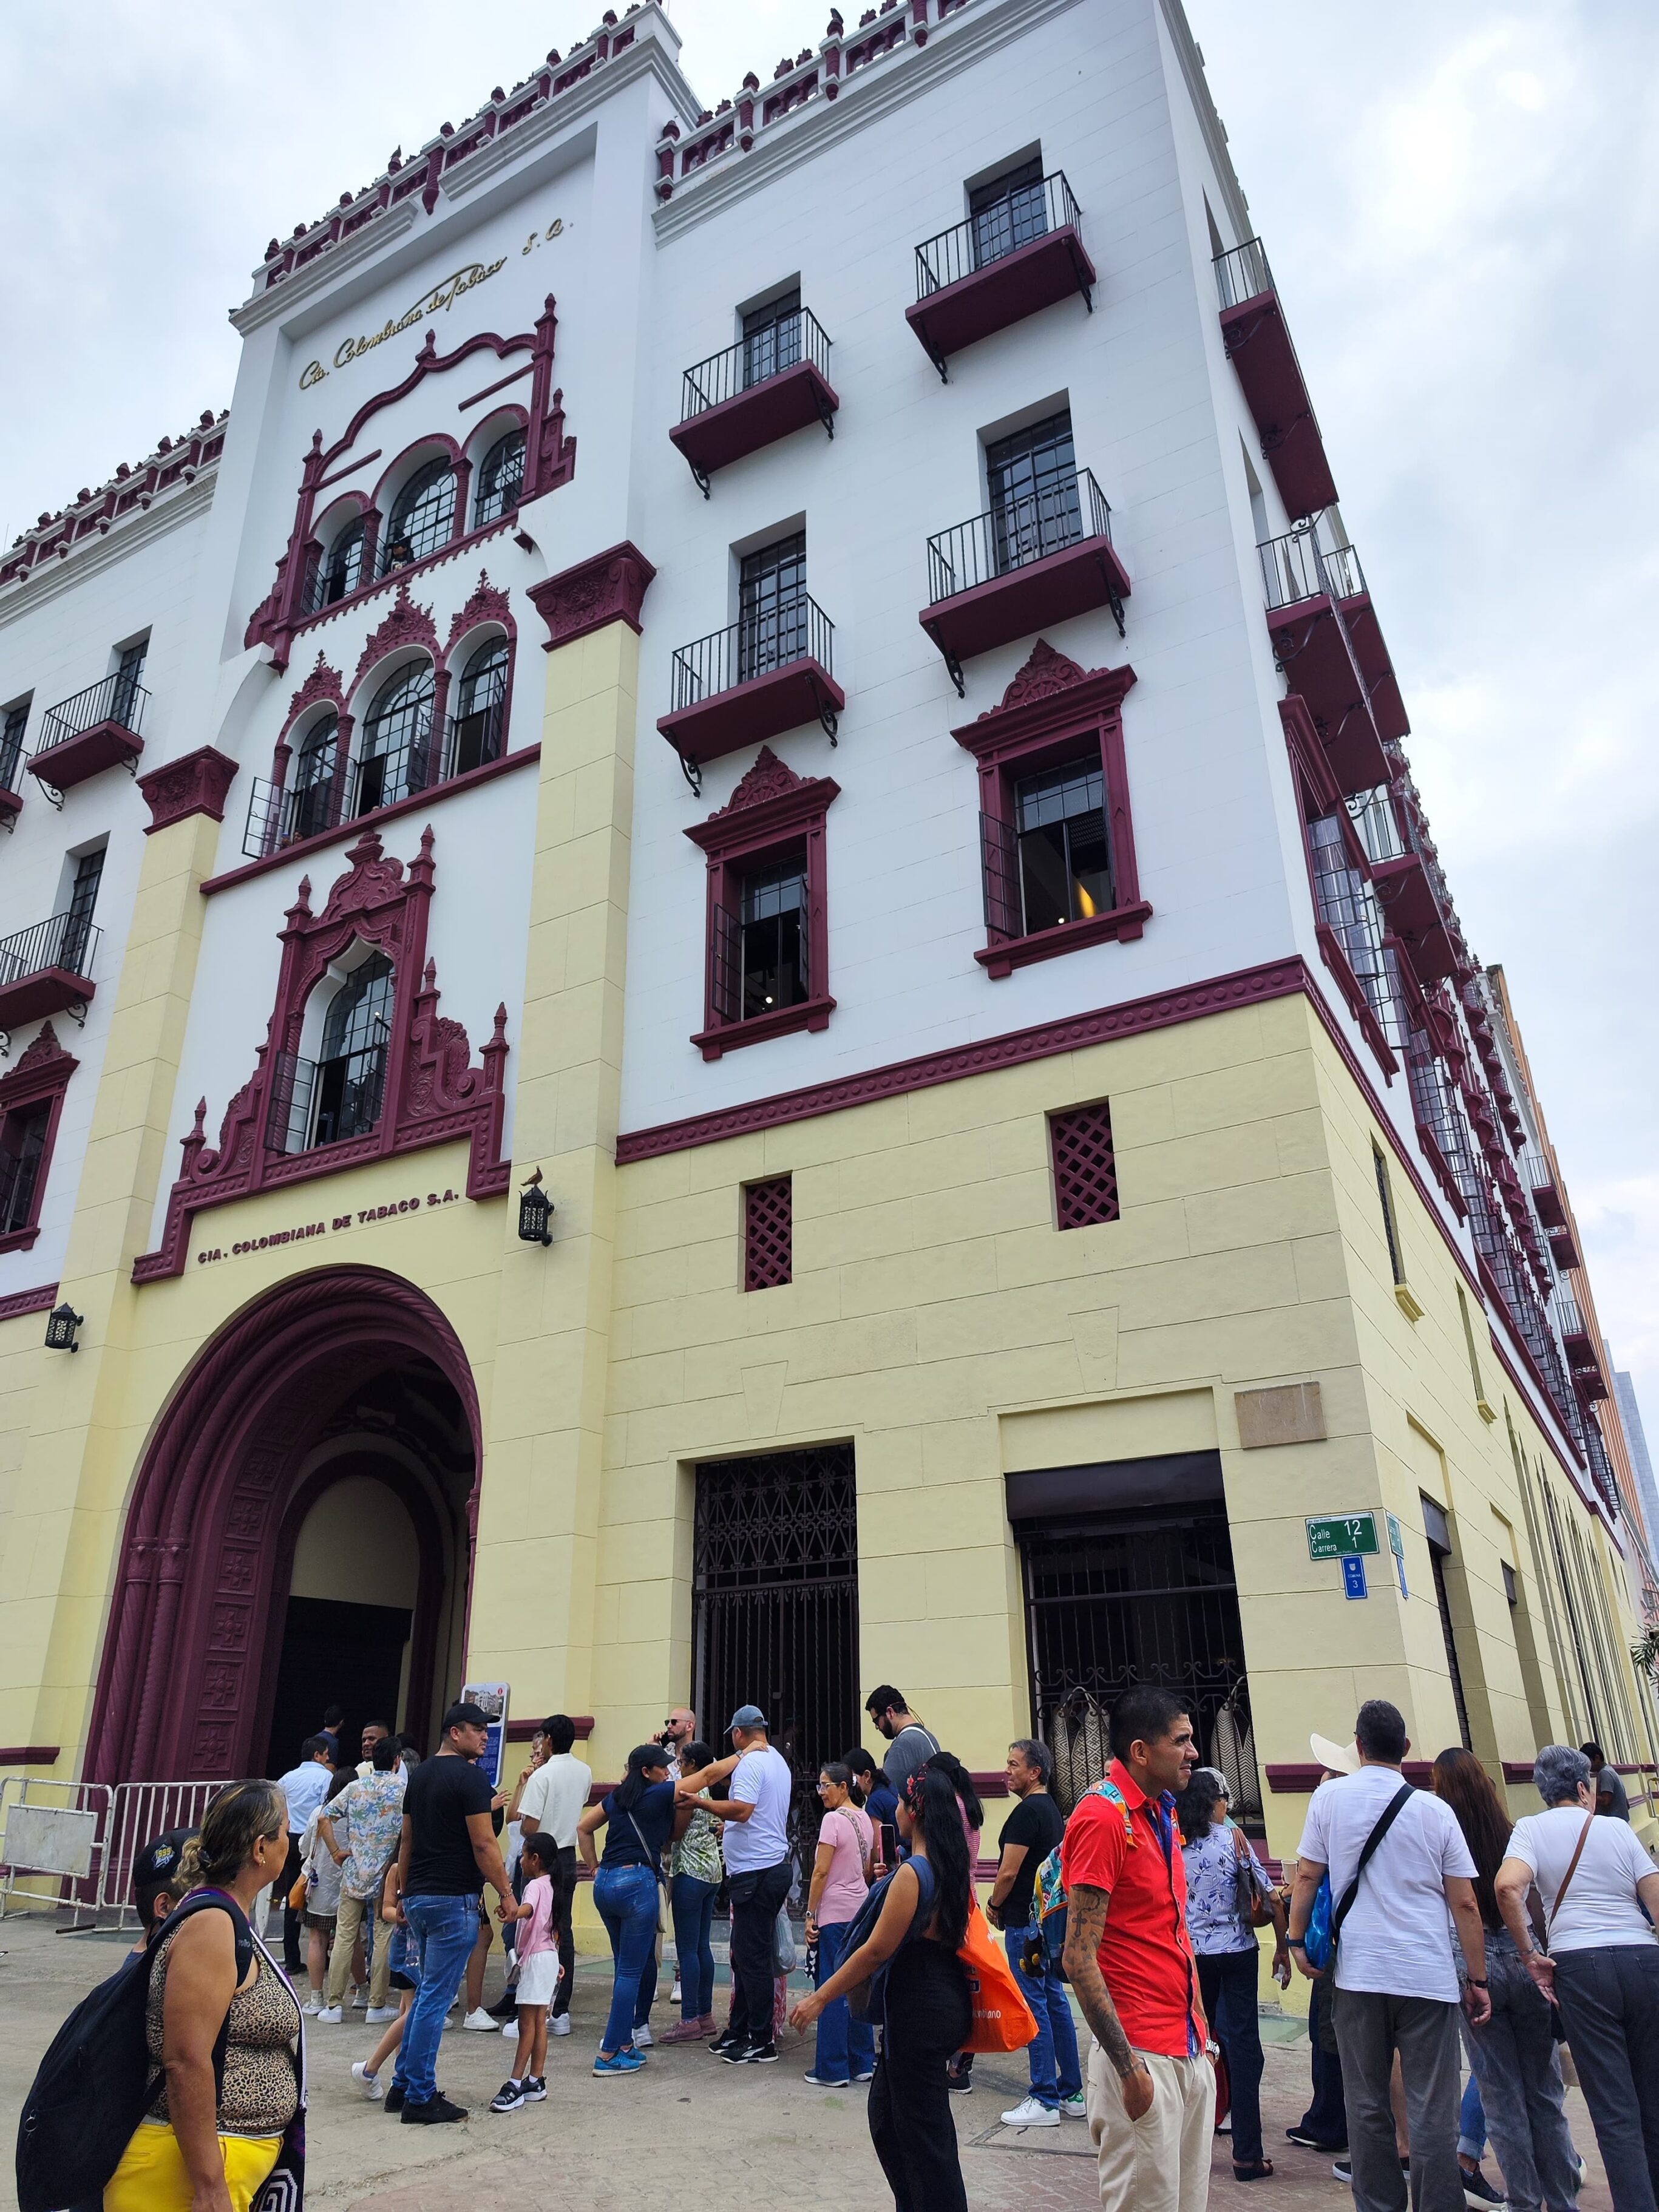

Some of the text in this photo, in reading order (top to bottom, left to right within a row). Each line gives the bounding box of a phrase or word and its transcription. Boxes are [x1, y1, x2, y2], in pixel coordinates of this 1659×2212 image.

[401, 256, 507, 311] Tabaco
[426, 291, 445, 314] de
[333, 309, 424, 368] Colombiana
[197, 1189, 459, 1264] CIA. COLOMBIANA DE TABACO S.A.
[1309, 1519, 1362, 1540] Calle 12
[1311, 1536, 1357, 1553] Carrera 1
[1352, 1579, 1359, 1589] 3
[155, 1847, 172, 1859] 1999
